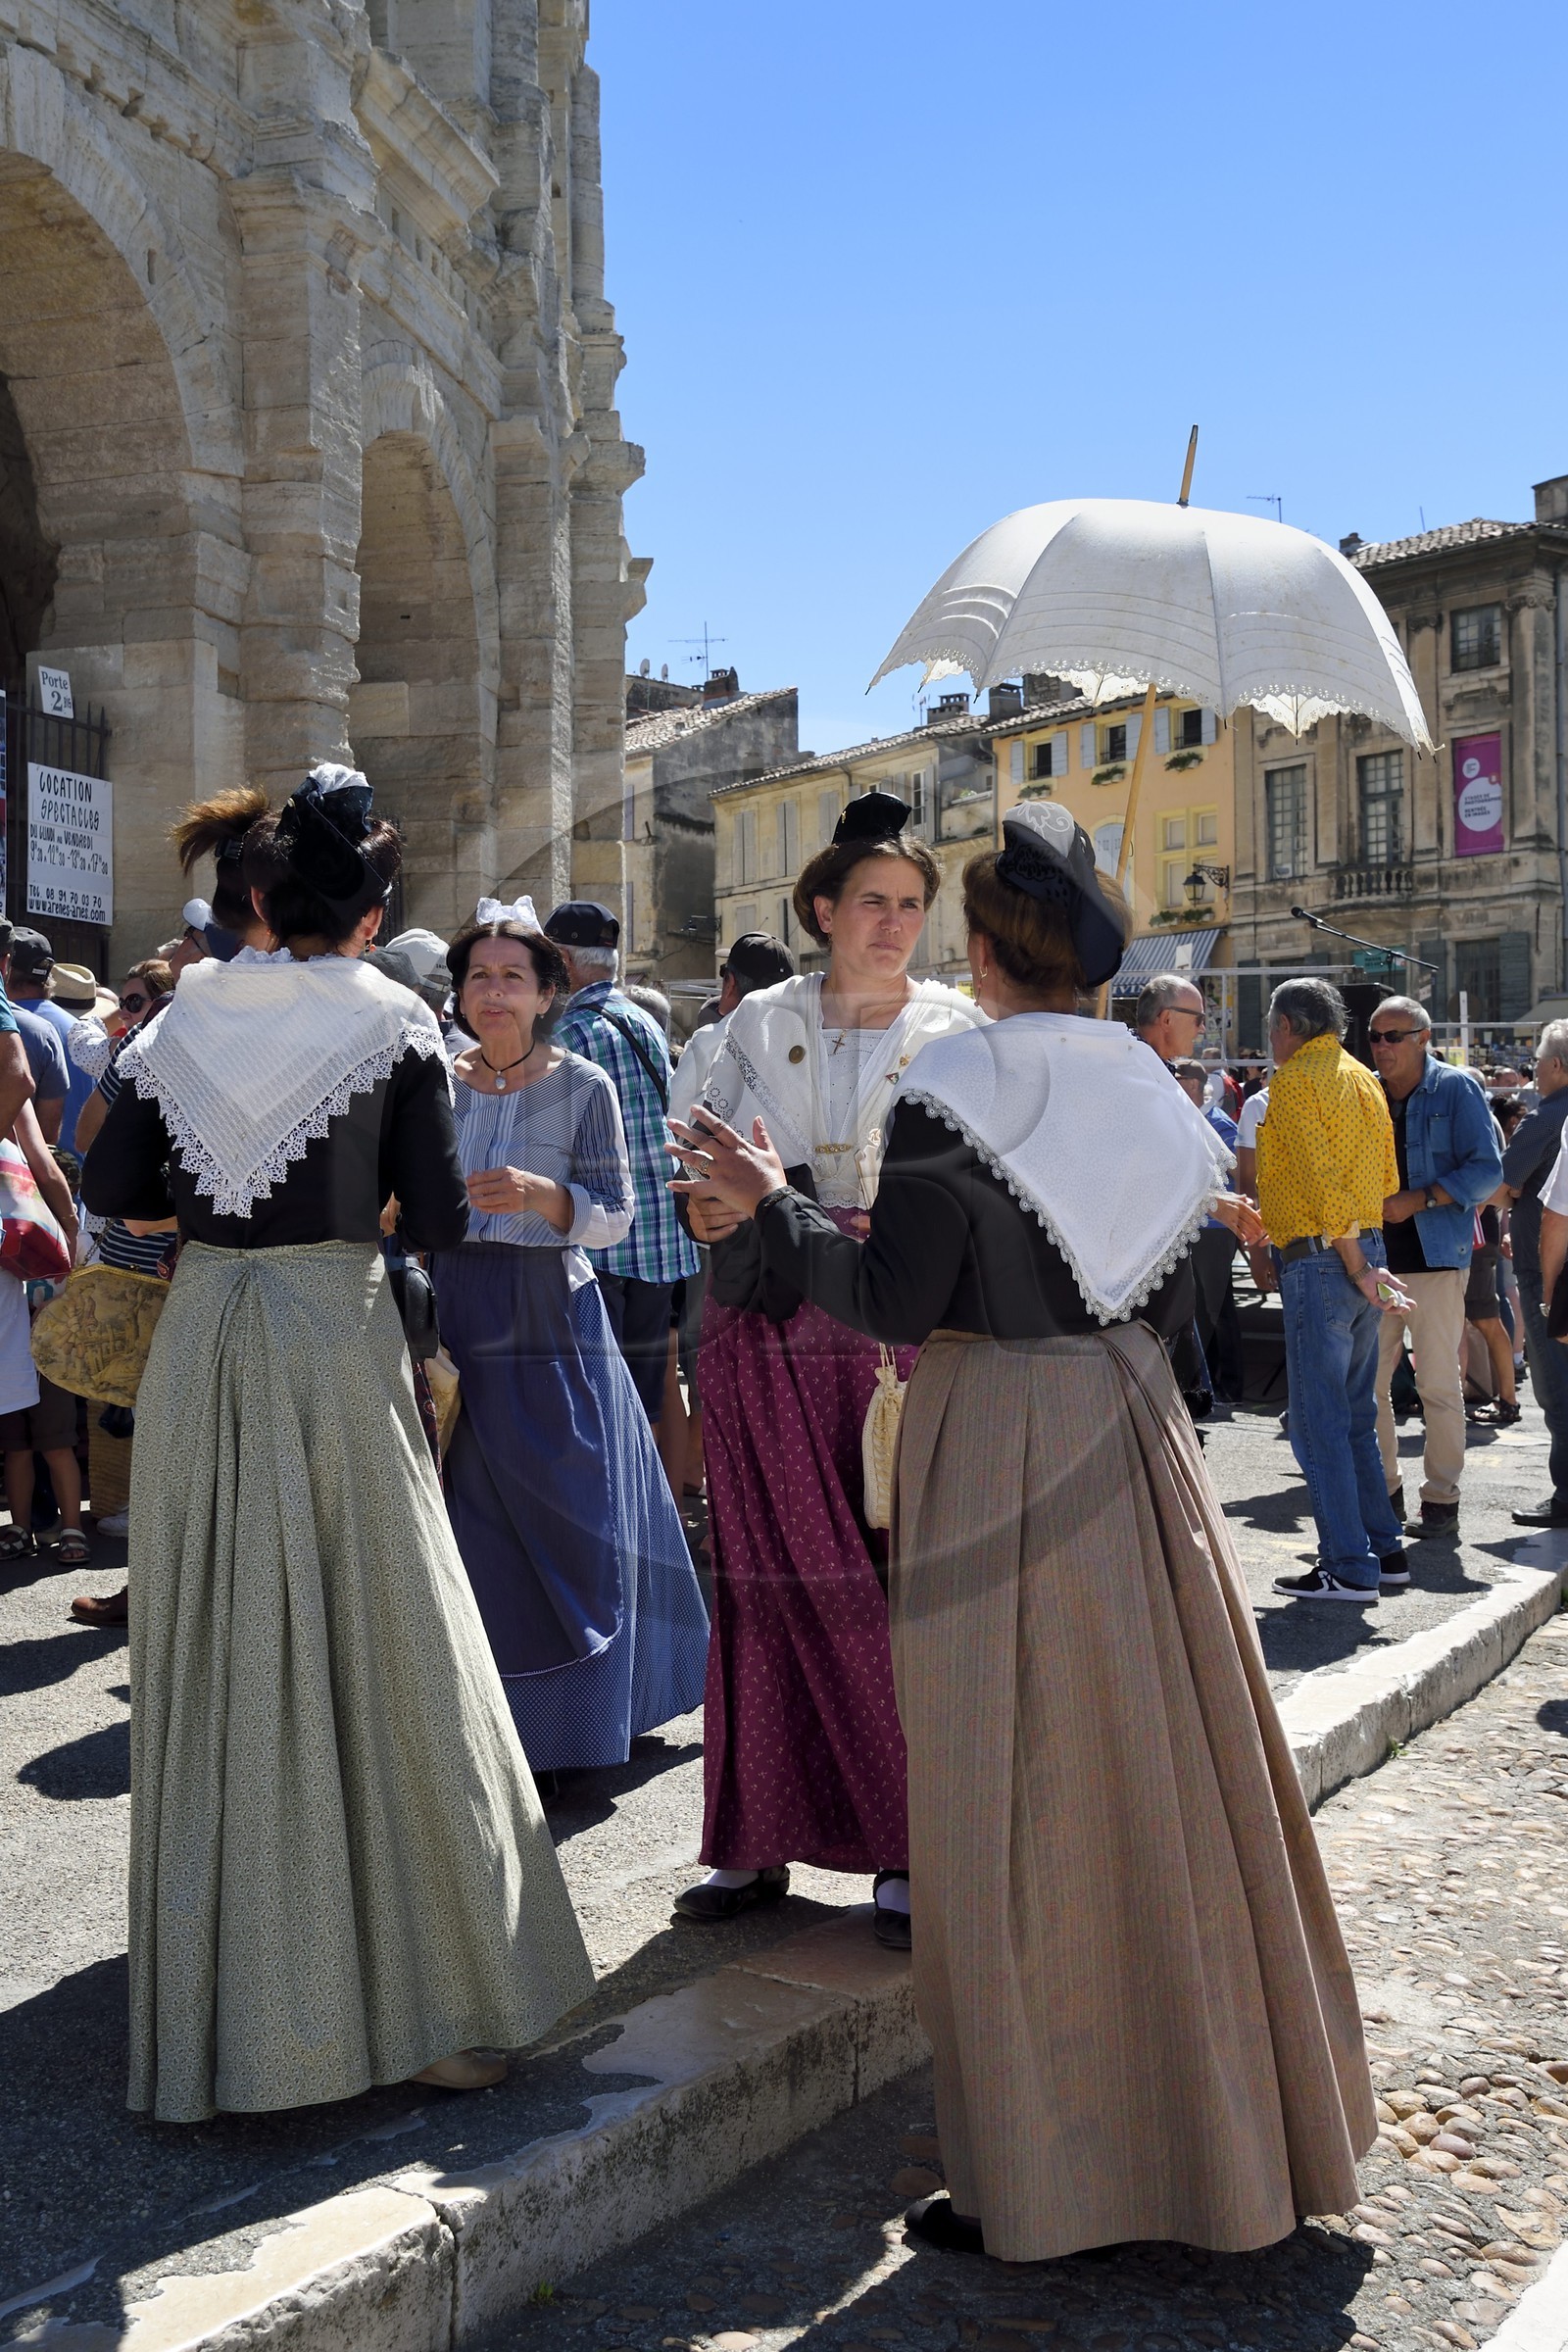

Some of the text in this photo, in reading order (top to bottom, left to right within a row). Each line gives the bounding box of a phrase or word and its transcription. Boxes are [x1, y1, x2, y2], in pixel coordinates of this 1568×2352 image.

[41, 671, 69, 690] Porte
[51, 691, 63, 711] 2
[39, 771, 92, 803] LOCATION
[41, 799, 100, 831] SPECTACLES
[30, 823, 37, 838] DU
[64, 830, 93, 851] VENDREDI
[46, 888, 55, 901] 08
[59, 890, 67, 903] 91
[71, 892, 78, 905] 70
[81, 894, 90, 906] 03
[93, 896, 102, 908] 70
